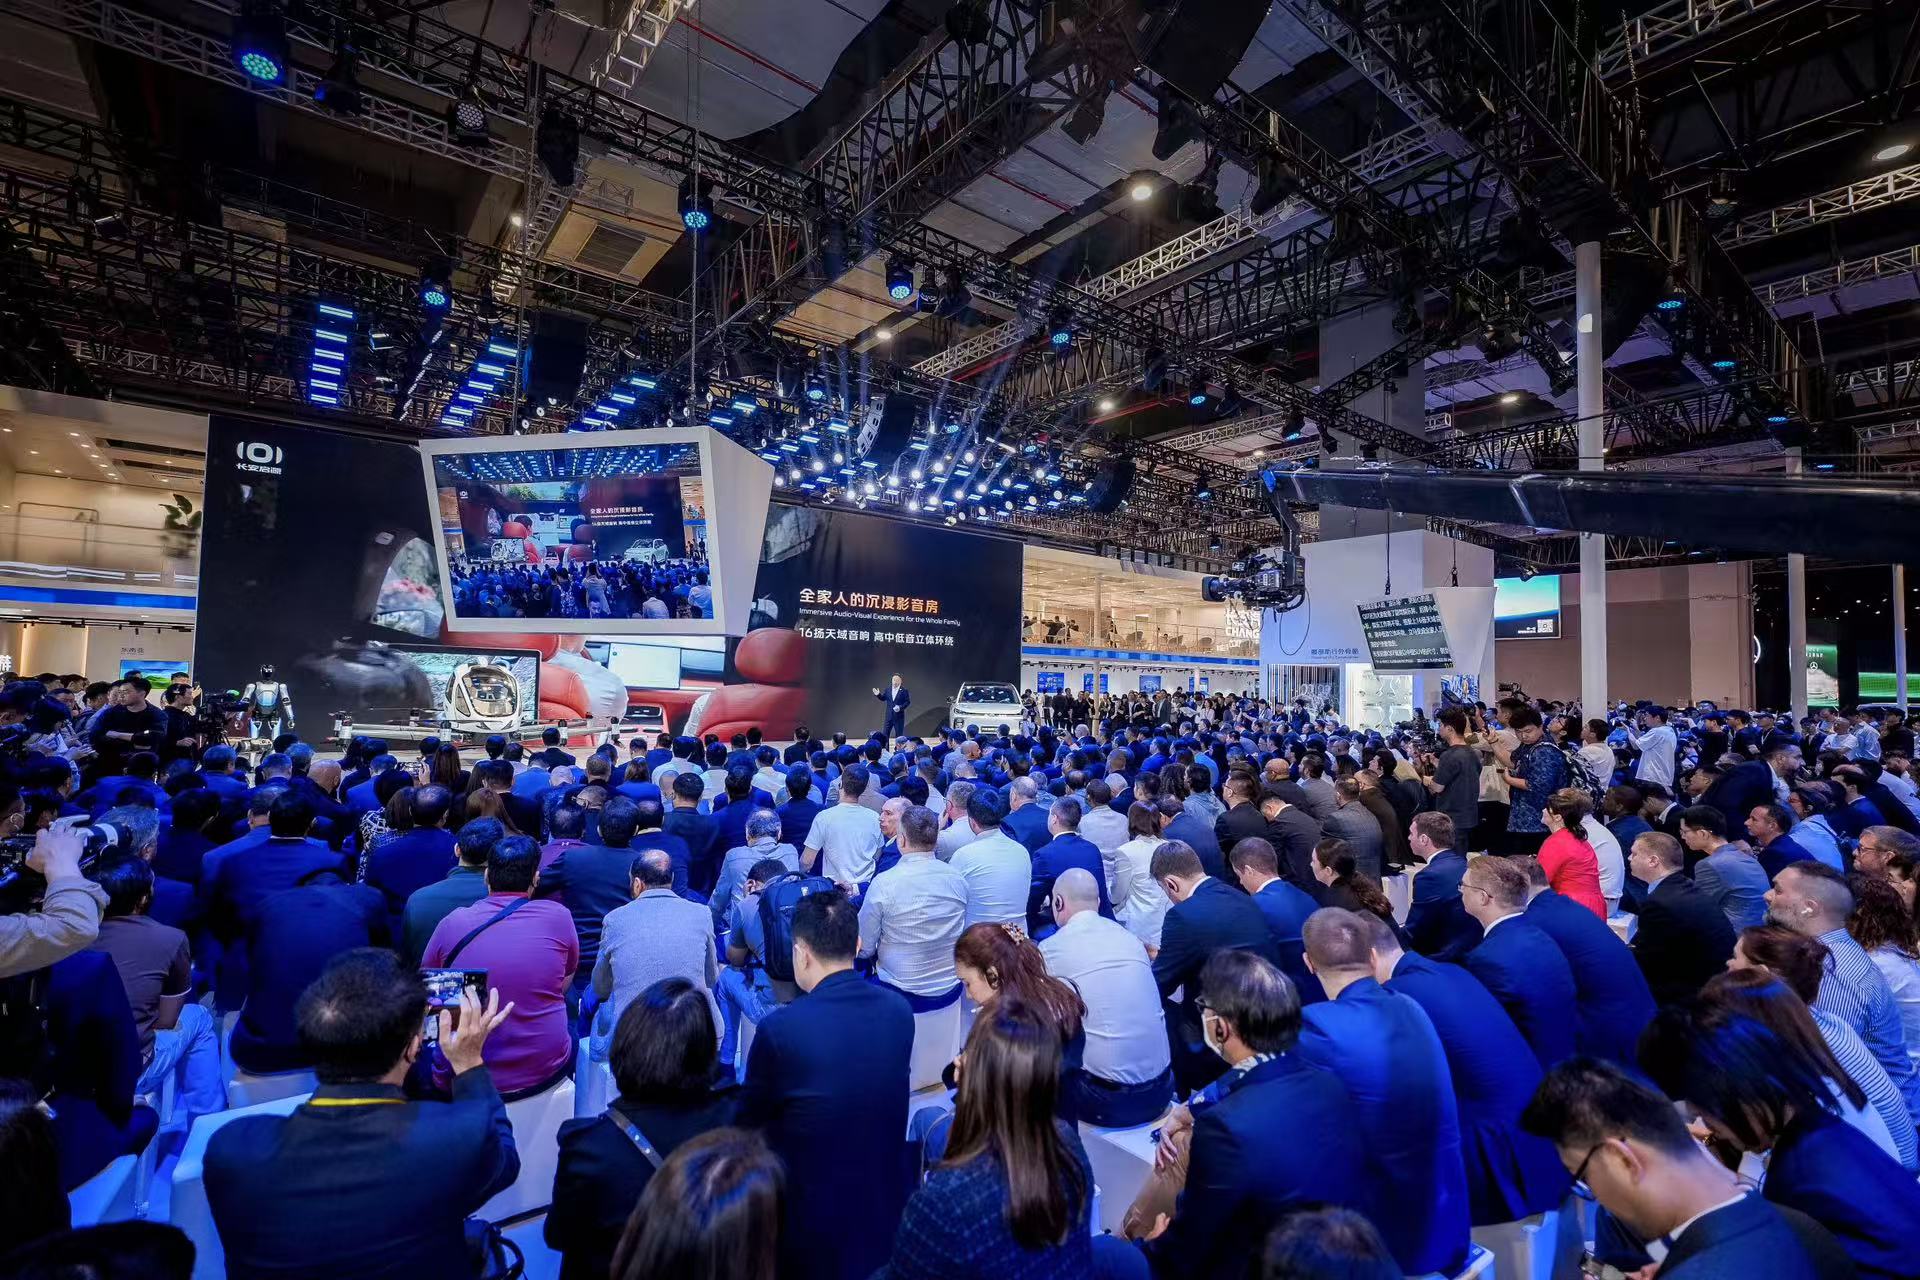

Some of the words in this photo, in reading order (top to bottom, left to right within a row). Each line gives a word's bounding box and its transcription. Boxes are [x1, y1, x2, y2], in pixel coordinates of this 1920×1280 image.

[799, 588, 938, 614] 全家人的沉浸影音房
[799, 607, 833, 617] Immersive
[834, 610, 872, 620] Audio-Visual
[873, 613, 905, 623] Experience
[905, 615, 914, 623] for
[925, 617, 943, 625] Whole
[943, 618, 961, 627] Family
[799, 627, 870, 641] 16扬天域音响
[874, 631, 954, 646] 高中低音立体环绕
